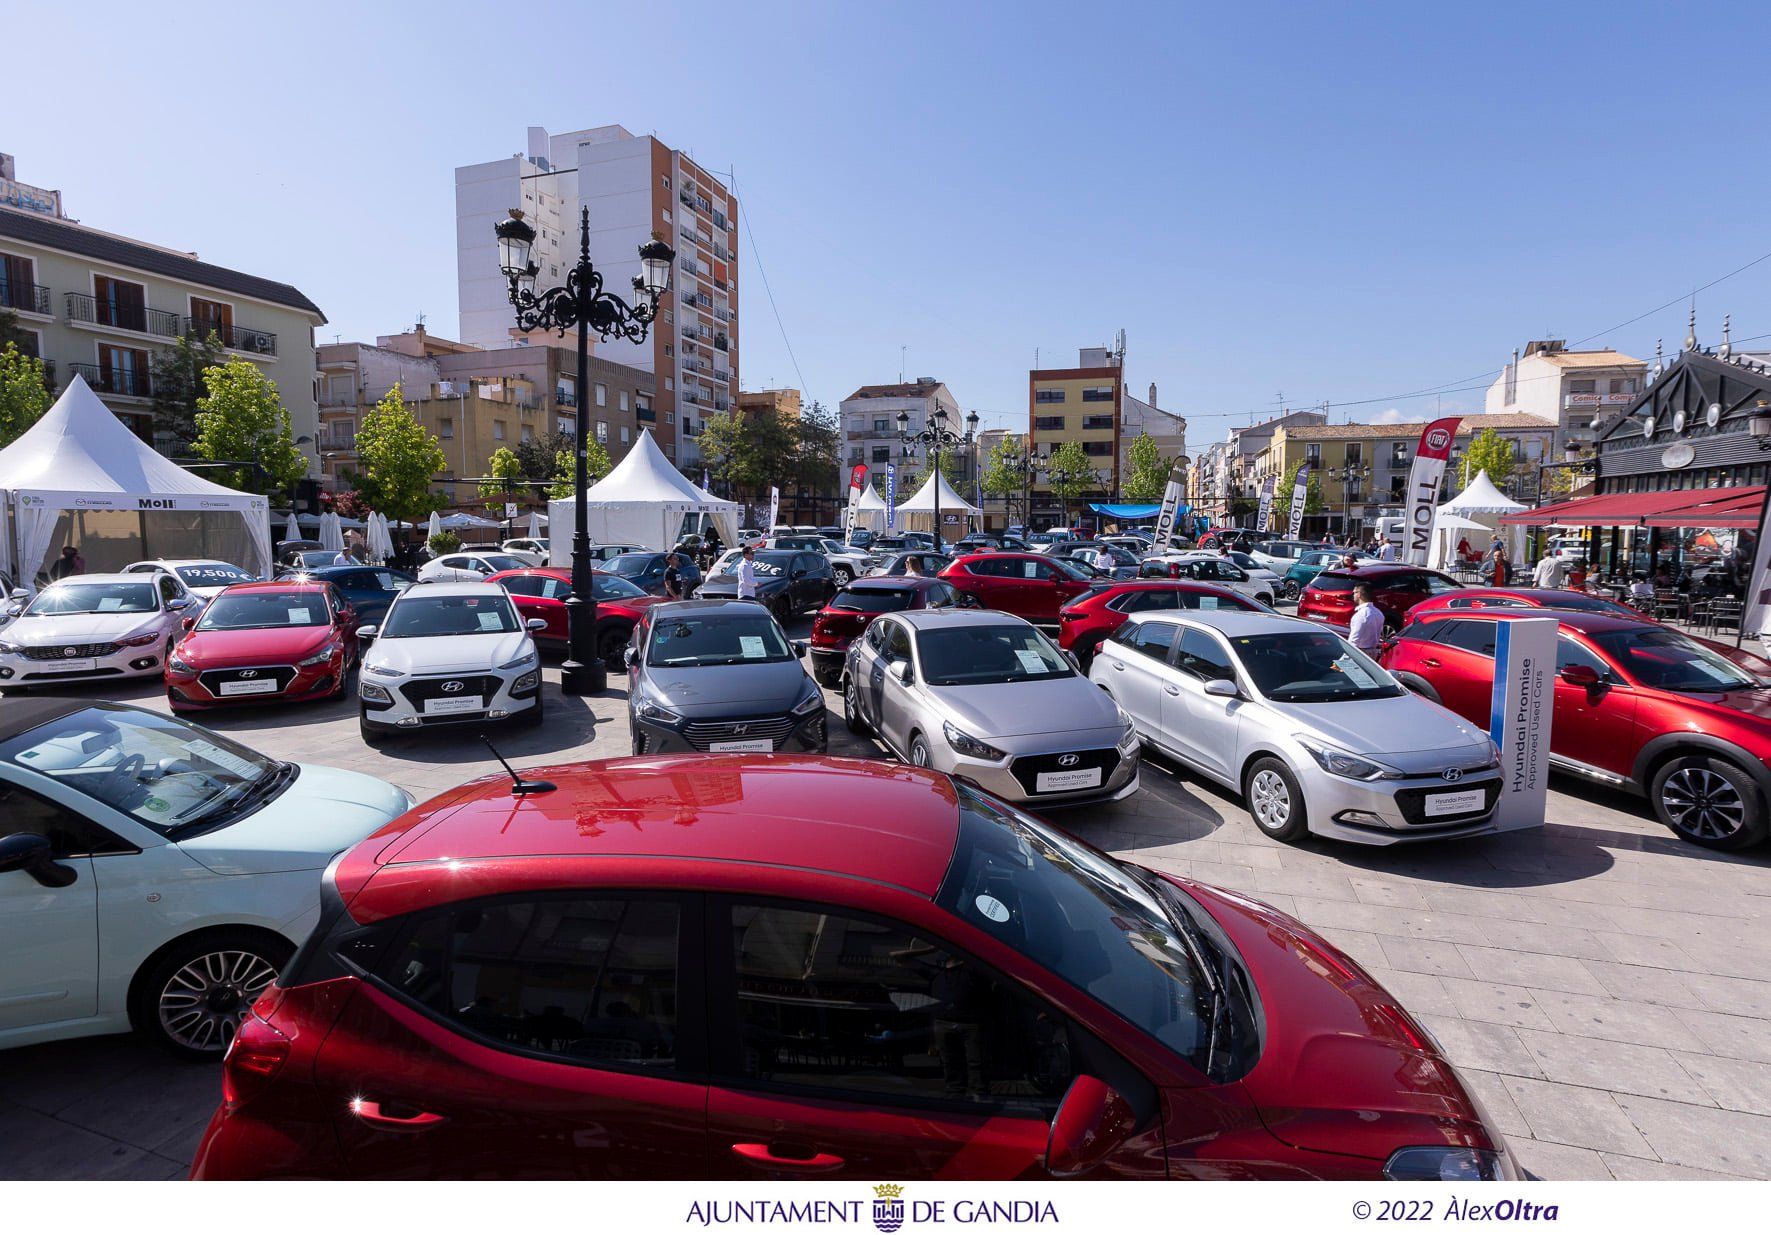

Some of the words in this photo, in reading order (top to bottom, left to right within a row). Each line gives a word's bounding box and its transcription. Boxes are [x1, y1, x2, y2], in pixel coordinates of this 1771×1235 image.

[138, 498, 174, 509] Moll
[1155, 495, 1178, 545] MOLL
[1257, 499, 1270, 531] MOLL
[1290, 493, 1306, 535] MOLL
[1411, 475, 1439, 551] MOLL
[1517, 658, 1531, 723] Promise
[1533, 670, 1543, 698] Cars
[1531, 701, 1541, 731] Used
[1512, 728, 1527, 793] Hyundai
[1527, 734, 1539, 790] Approved
